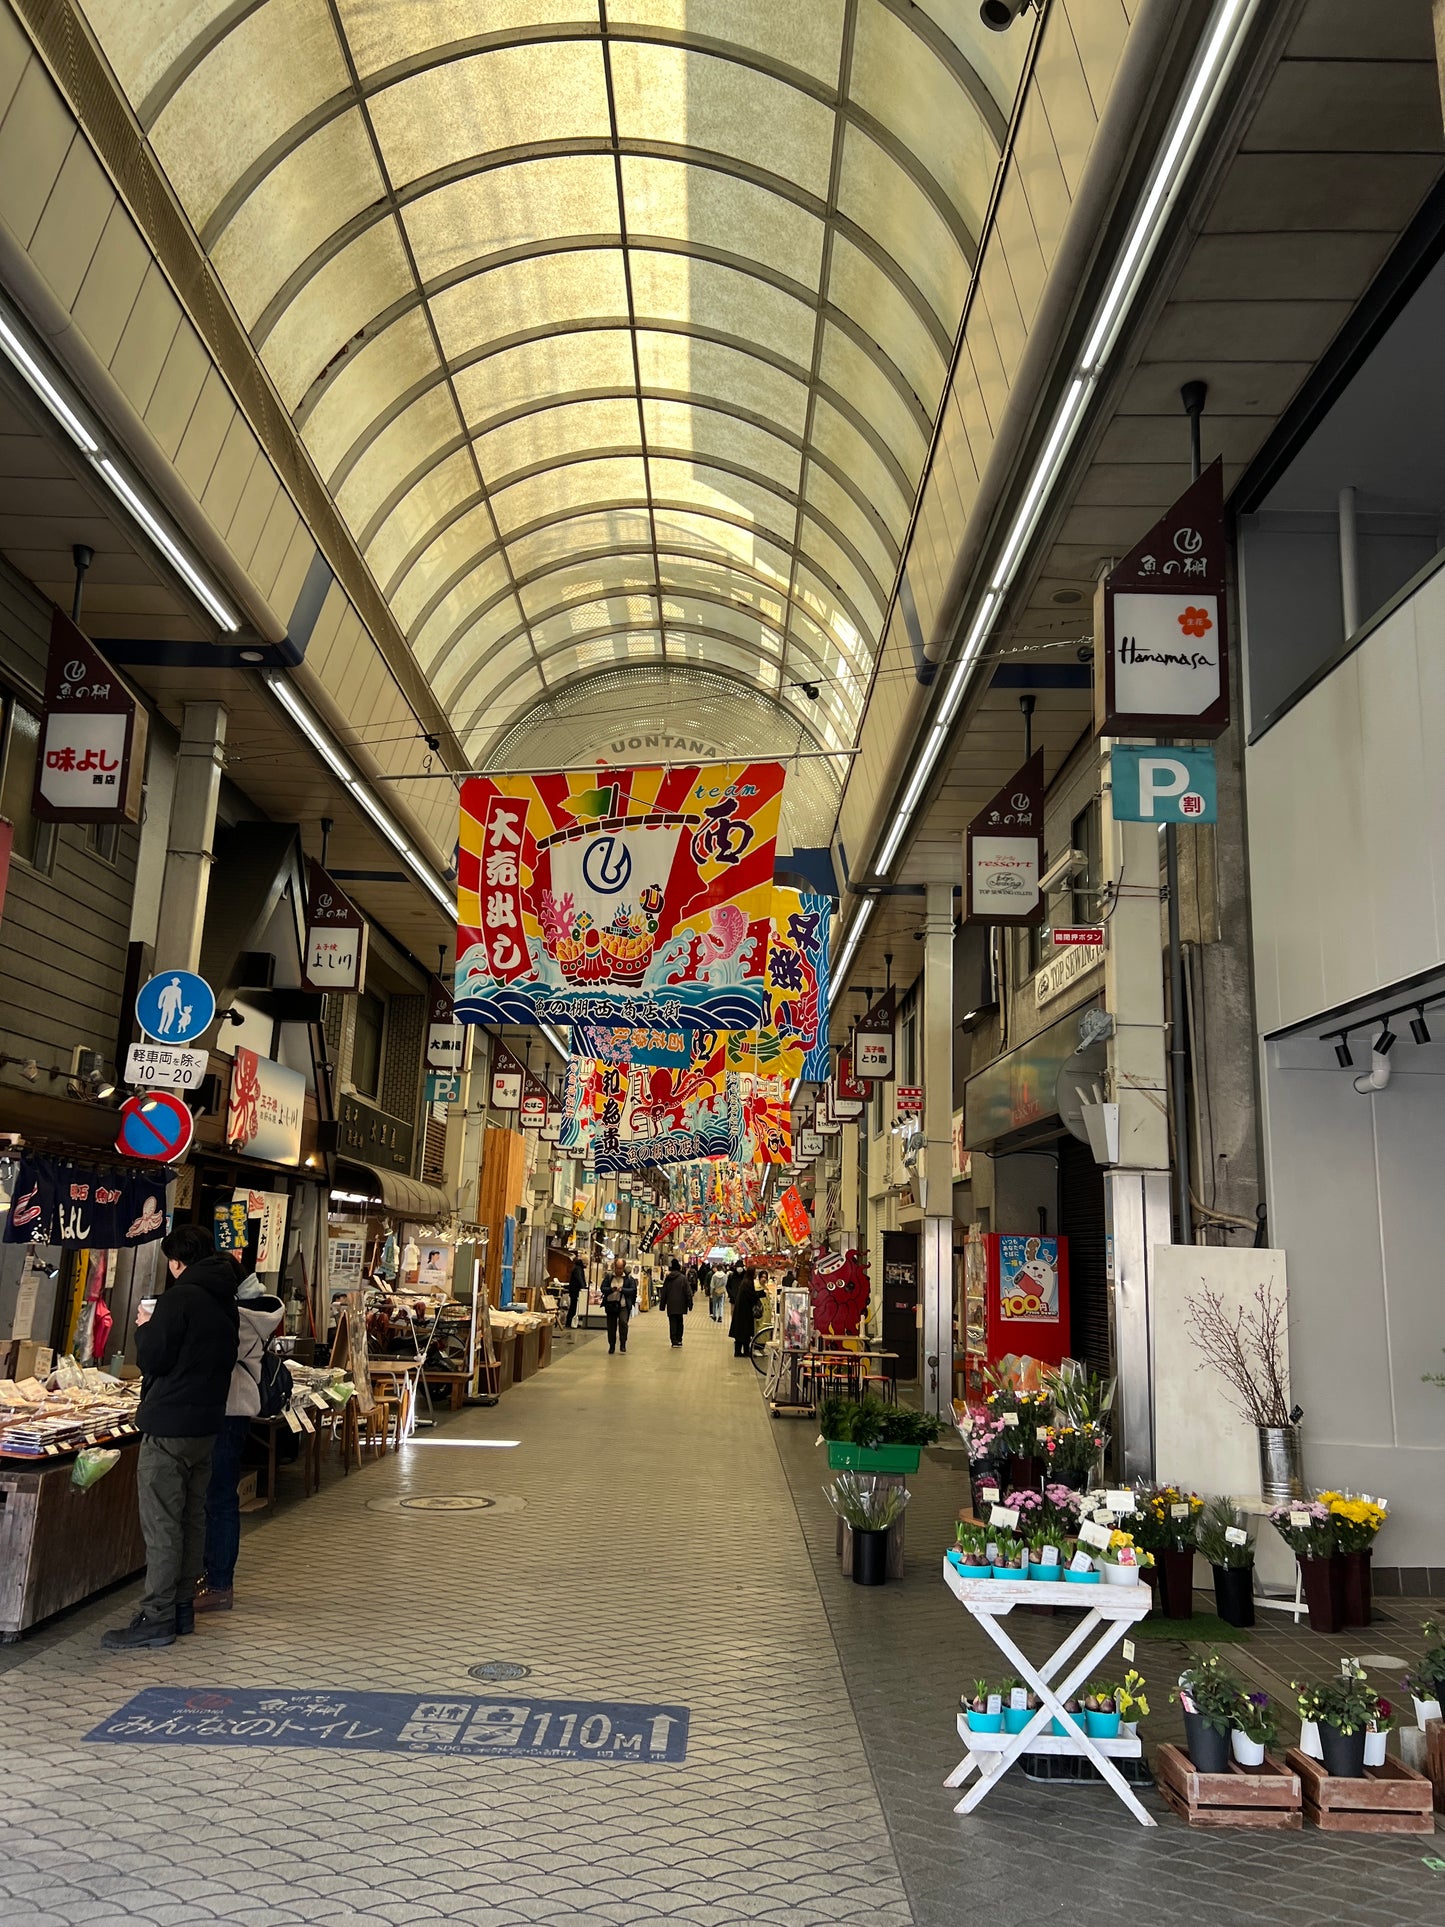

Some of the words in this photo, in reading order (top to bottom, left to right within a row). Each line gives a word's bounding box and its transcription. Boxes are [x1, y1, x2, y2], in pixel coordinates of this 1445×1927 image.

[1137, 554, 1207, 577] 魚の棚
[1118, 636, 1216, 670] Hanamasa
[56, 684, 109, 700] 魚の棚
[611, 735, 717, 758] UONTANA
[46, 749, 119, 772] 味よし
[92, 775, 116, 785] 西店
[1138, 757, 1190, 817] P
[1182, 796, 1202, 814] 割
[694, 783, 757, 799] team
[988, 811, 1033, 825] 魚の棚
[977, 860, 1034, 868] ressort
[486, 807, 522, 971] 大売出し
[314, 907, 348, 919] 魚の棚
[312, 952, 352, 970] よし川
[1050, 960, 1065, 991] TOP
[535, 996, 681, 1020] 魚の棚西商店街
[132, 1049, 202, 1068] 軽車両を除く
[433, 1079, 452, 1100] P
[524, 1101, 543, 1109] たばこ
[230, 1203, 249, 1248] 生ビール
[243, 1699, 347, 1717] 魚の棚
[107, 1715, 383, 1740] みんなのトイレ
